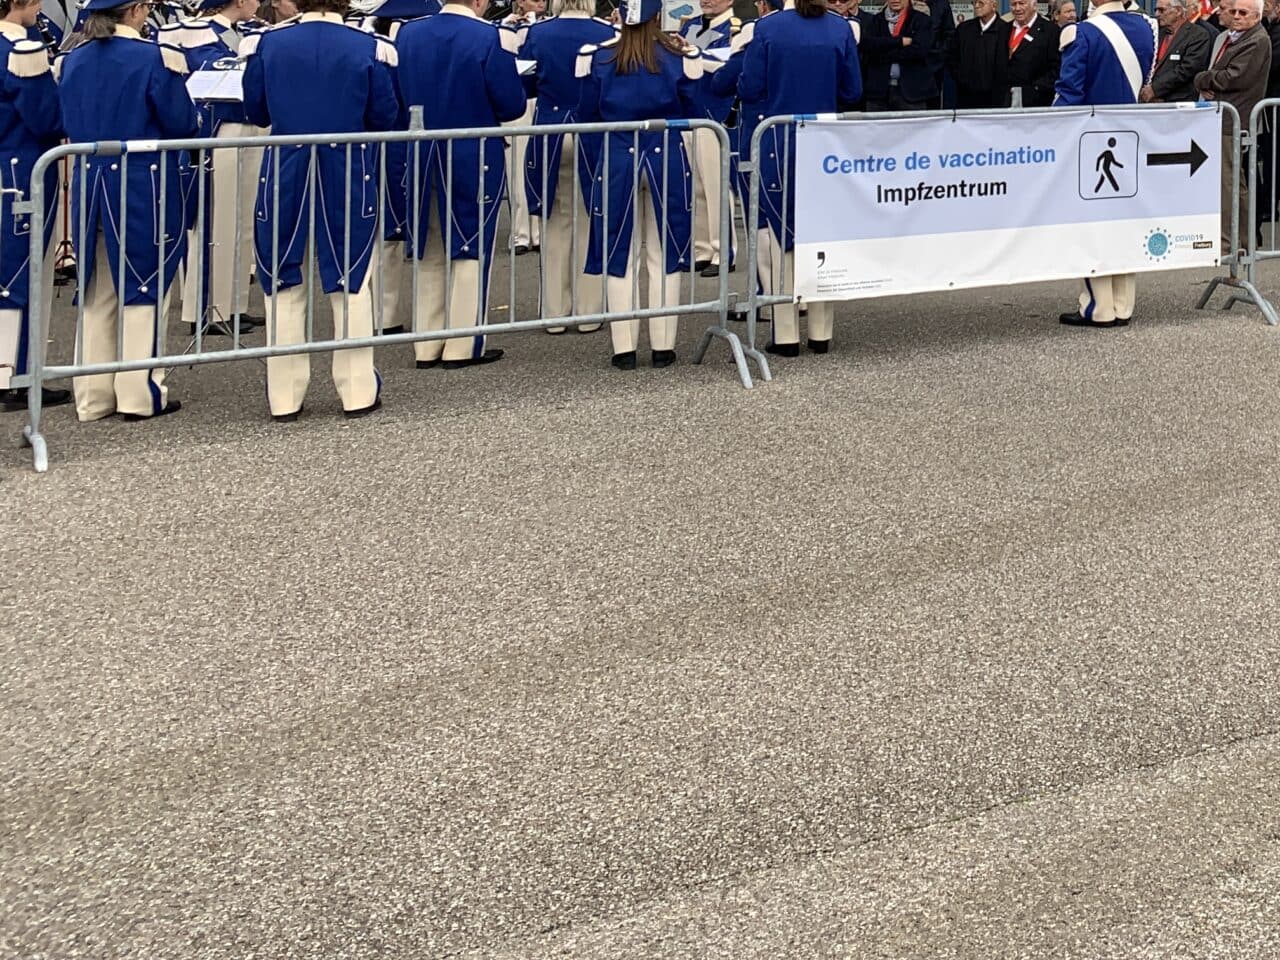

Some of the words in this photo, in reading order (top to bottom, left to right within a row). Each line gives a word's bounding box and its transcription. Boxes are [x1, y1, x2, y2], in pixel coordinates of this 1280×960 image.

[822, 153, 897, 175] Centre
[904, 151, 931, 171] de
[938, 146, 1056, 169] vaccination
[876, 179, 1008, 206] Impfzentrum
